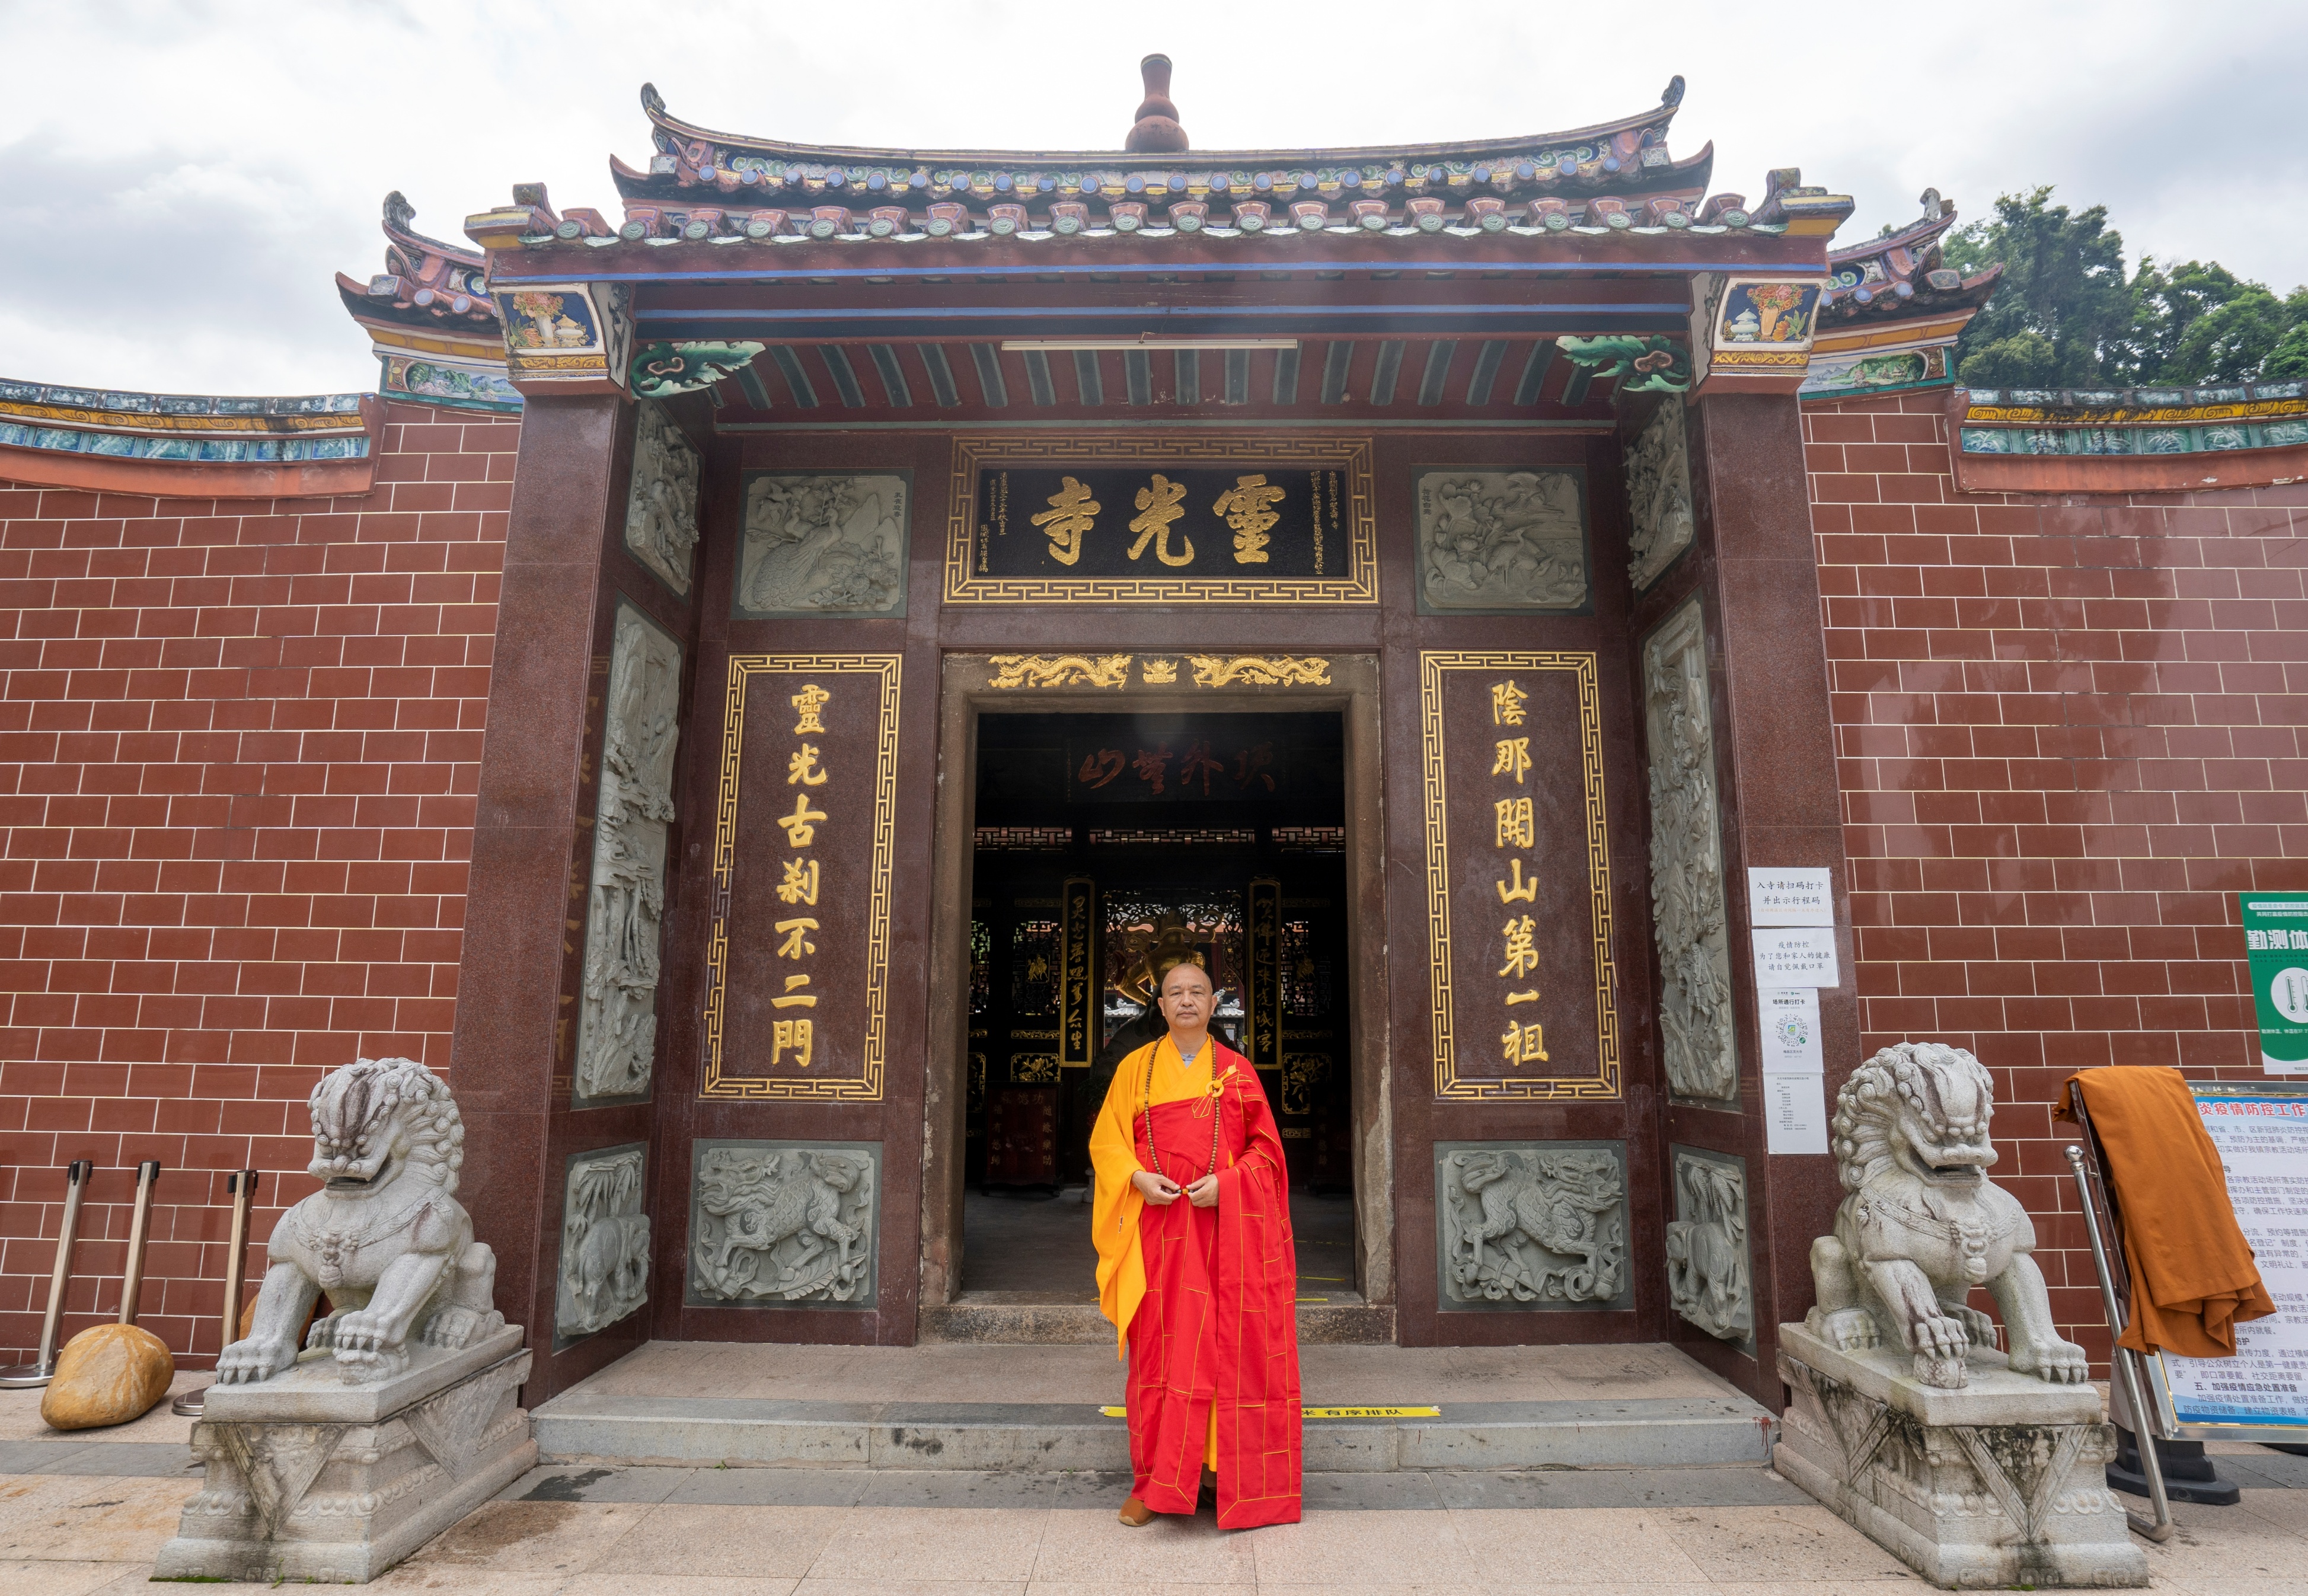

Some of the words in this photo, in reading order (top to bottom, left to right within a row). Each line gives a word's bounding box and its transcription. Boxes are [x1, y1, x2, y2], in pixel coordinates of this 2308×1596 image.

[1030, 474, 1286, 566] 靈光寺
[1757, 881, 1824, 890] 入寺请扫码打卡
[1763, 896, 1820, 905] 并出示行程码
[2246, 929, 2308, 950] 勤测体
[1760, 952, 1831, 960] 为了您和家人的健康
[1768, 962, 1824, 971] 请自觉佩戴口罩
[2198, 1102, 2308, 1116] 炎疫情防控工作
[2210, 1135, 2308, 1144] 主、预防为主的基调，严格
[2243, 1228, 2308, 1236] 分流、预约等措施
[2171, 1359, 2308, 1369] 式，引导公众树立个人是第一健康责
[2194, 1382, 2297, 1392] 五、加强疫情应急处置准备
